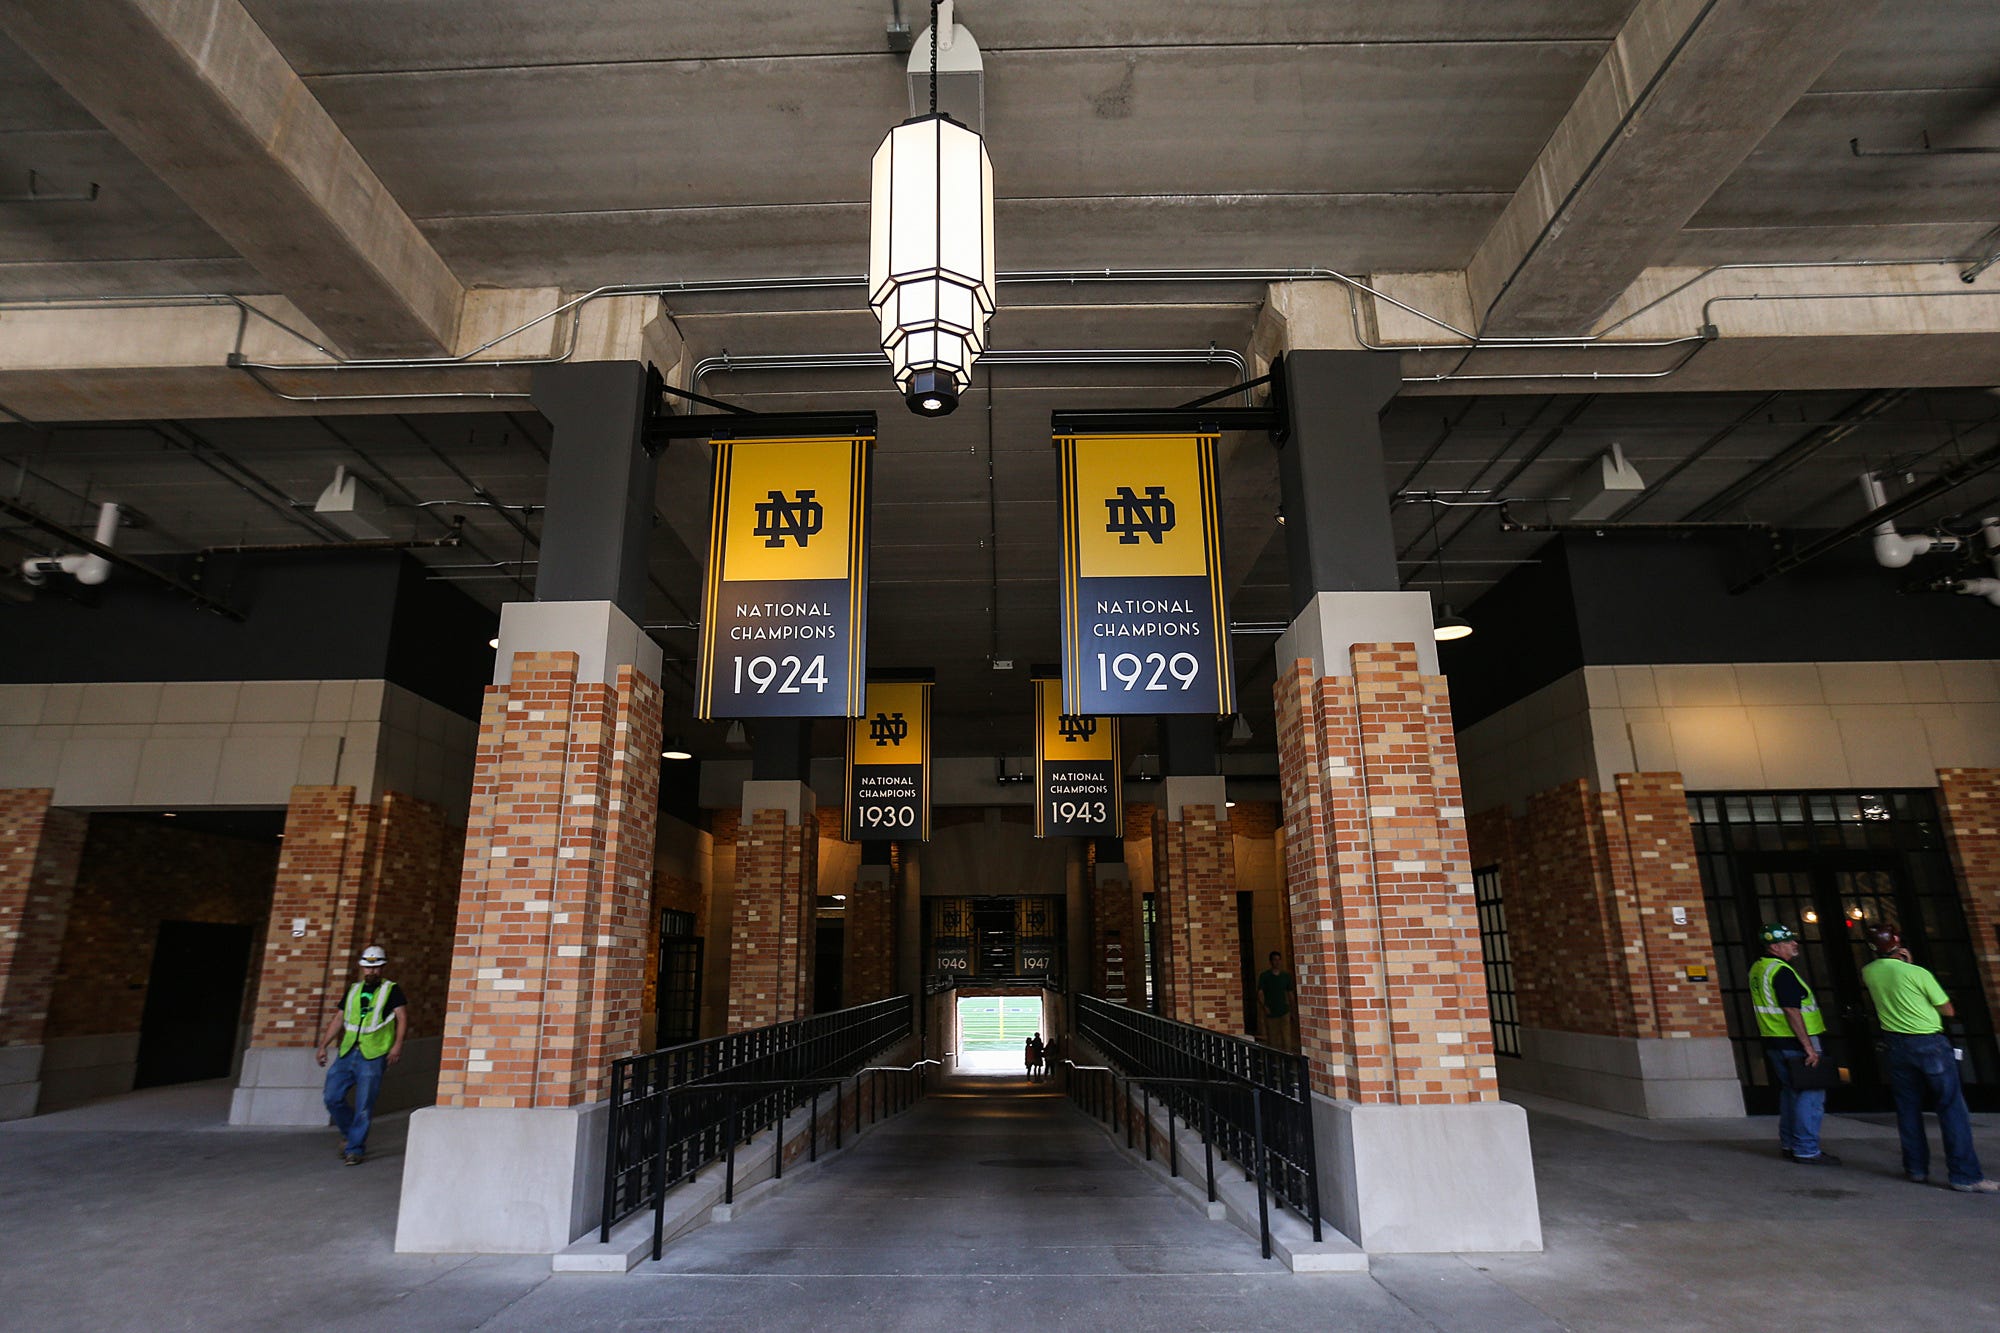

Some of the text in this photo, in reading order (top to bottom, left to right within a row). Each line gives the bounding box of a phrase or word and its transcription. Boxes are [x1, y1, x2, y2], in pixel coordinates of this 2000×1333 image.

[736, 603, 831, 618] NATIONAL
[1097, 600, 1193, 614] NATIONAL
[730, 625, 836, 640] CHAMPIONS
[1093, 622, 1200, 637] CHAMPIONS
[732, 655, 828, 694] 1924
[1097, 652, 1199, 691] 1929
[861, 776, 914, 785] NATIONAL
[1052, 773, 1105, 781] NATIONAL
[859, 789, 916, 798] CHAMPIONS
[1050, 785, 1107, 794] CHAMPIONS
[859, 806, 915, 828] 1930
[1052, 802, 1107, 823] 1943
[938, 958, 967, 969] 1946
[1024, 957, 1049, 969] 1947
